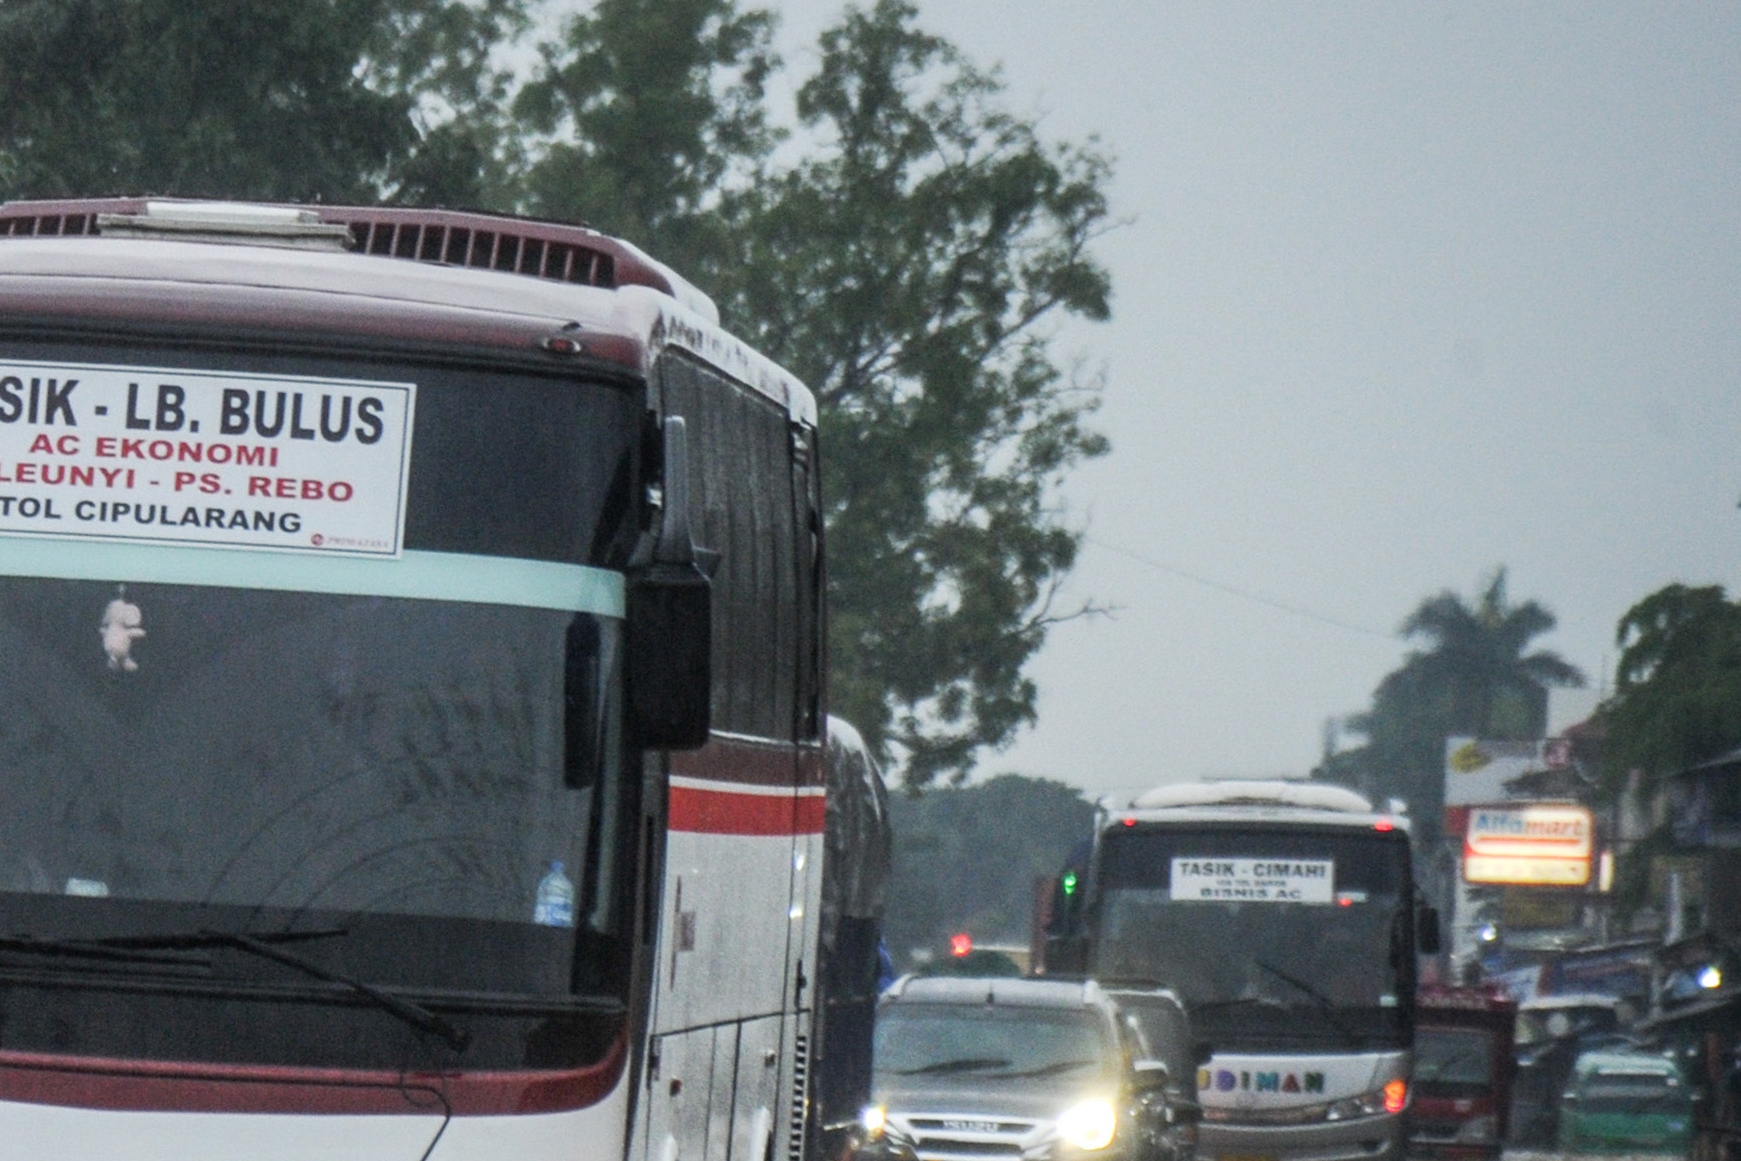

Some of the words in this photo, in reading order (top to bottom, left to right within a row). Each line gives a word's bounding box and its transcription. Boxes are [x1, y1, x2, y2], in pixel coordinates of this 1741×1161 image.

[95, 405, 108, 416] -
[126, 383, 199, 433] LB.
[220, 388, 384, 444] BULUS
[29, 434, 80, 455] AC
[95, 437, 278, 467] EKONOMI
[174, 471, 231, 495] PS.
[248, 476, 354, 502] REBO
[75, 500, 301, 533] CIPULARANG
[1179, 863, 1234, 877] TASIK
[1253, 864, 1325, 877] CIMAHI
[1276, 889, 1302, 899] AC
